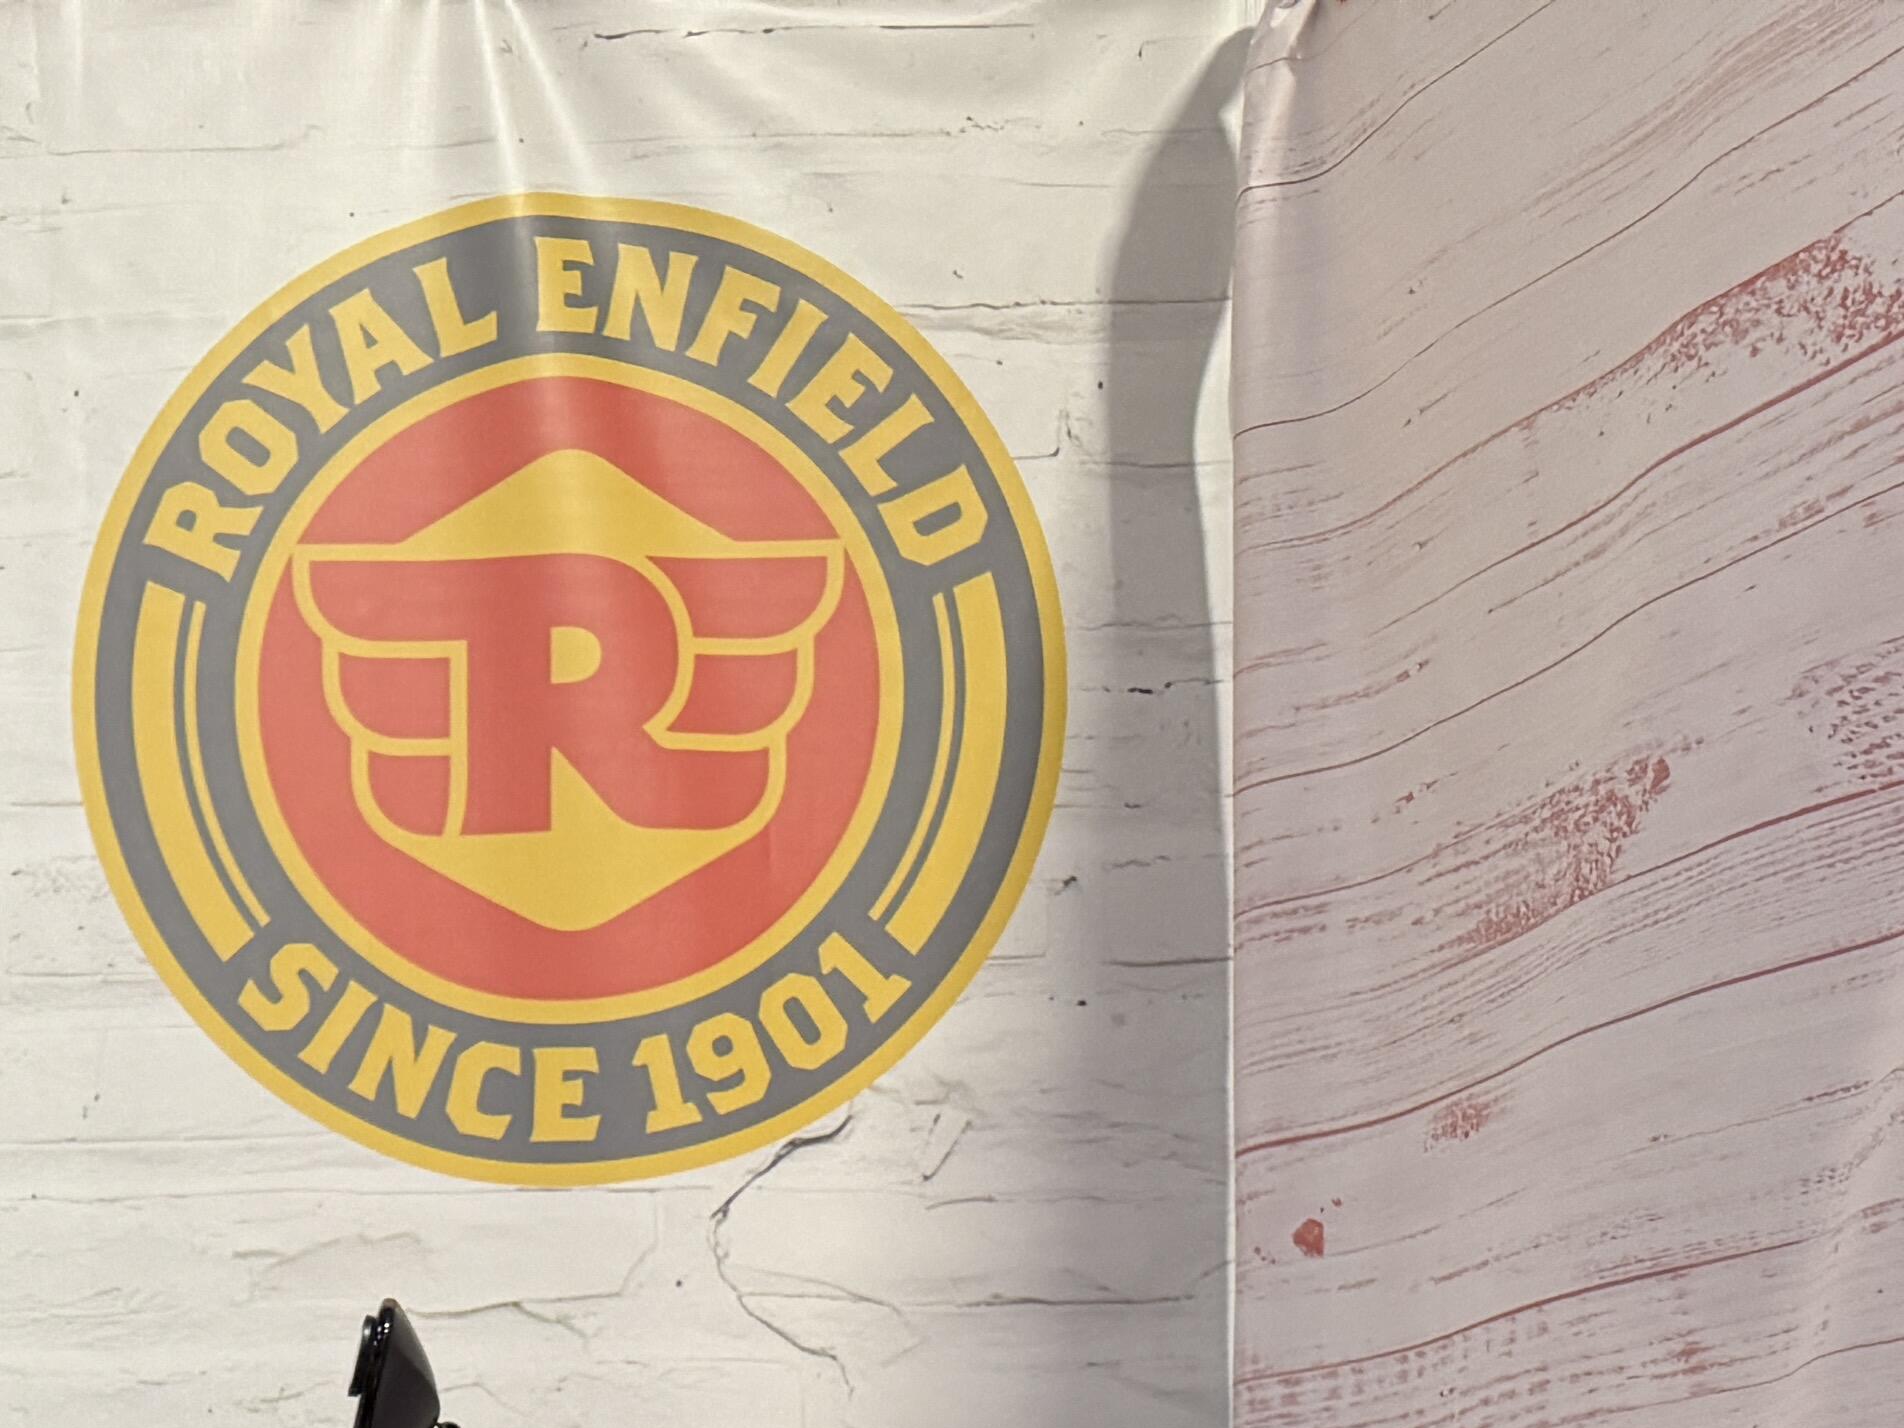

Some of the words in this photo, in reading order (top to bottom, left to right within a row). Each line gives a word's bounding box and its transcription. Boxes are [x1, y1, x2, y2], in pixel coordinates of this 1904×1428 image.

[144, 258, 501, 581] ROYAL
[534, 235, 992, 567] ENFIELD
[239, 943, 604, 1146] SINCE
[633, 932, 914, 1135] 1901
